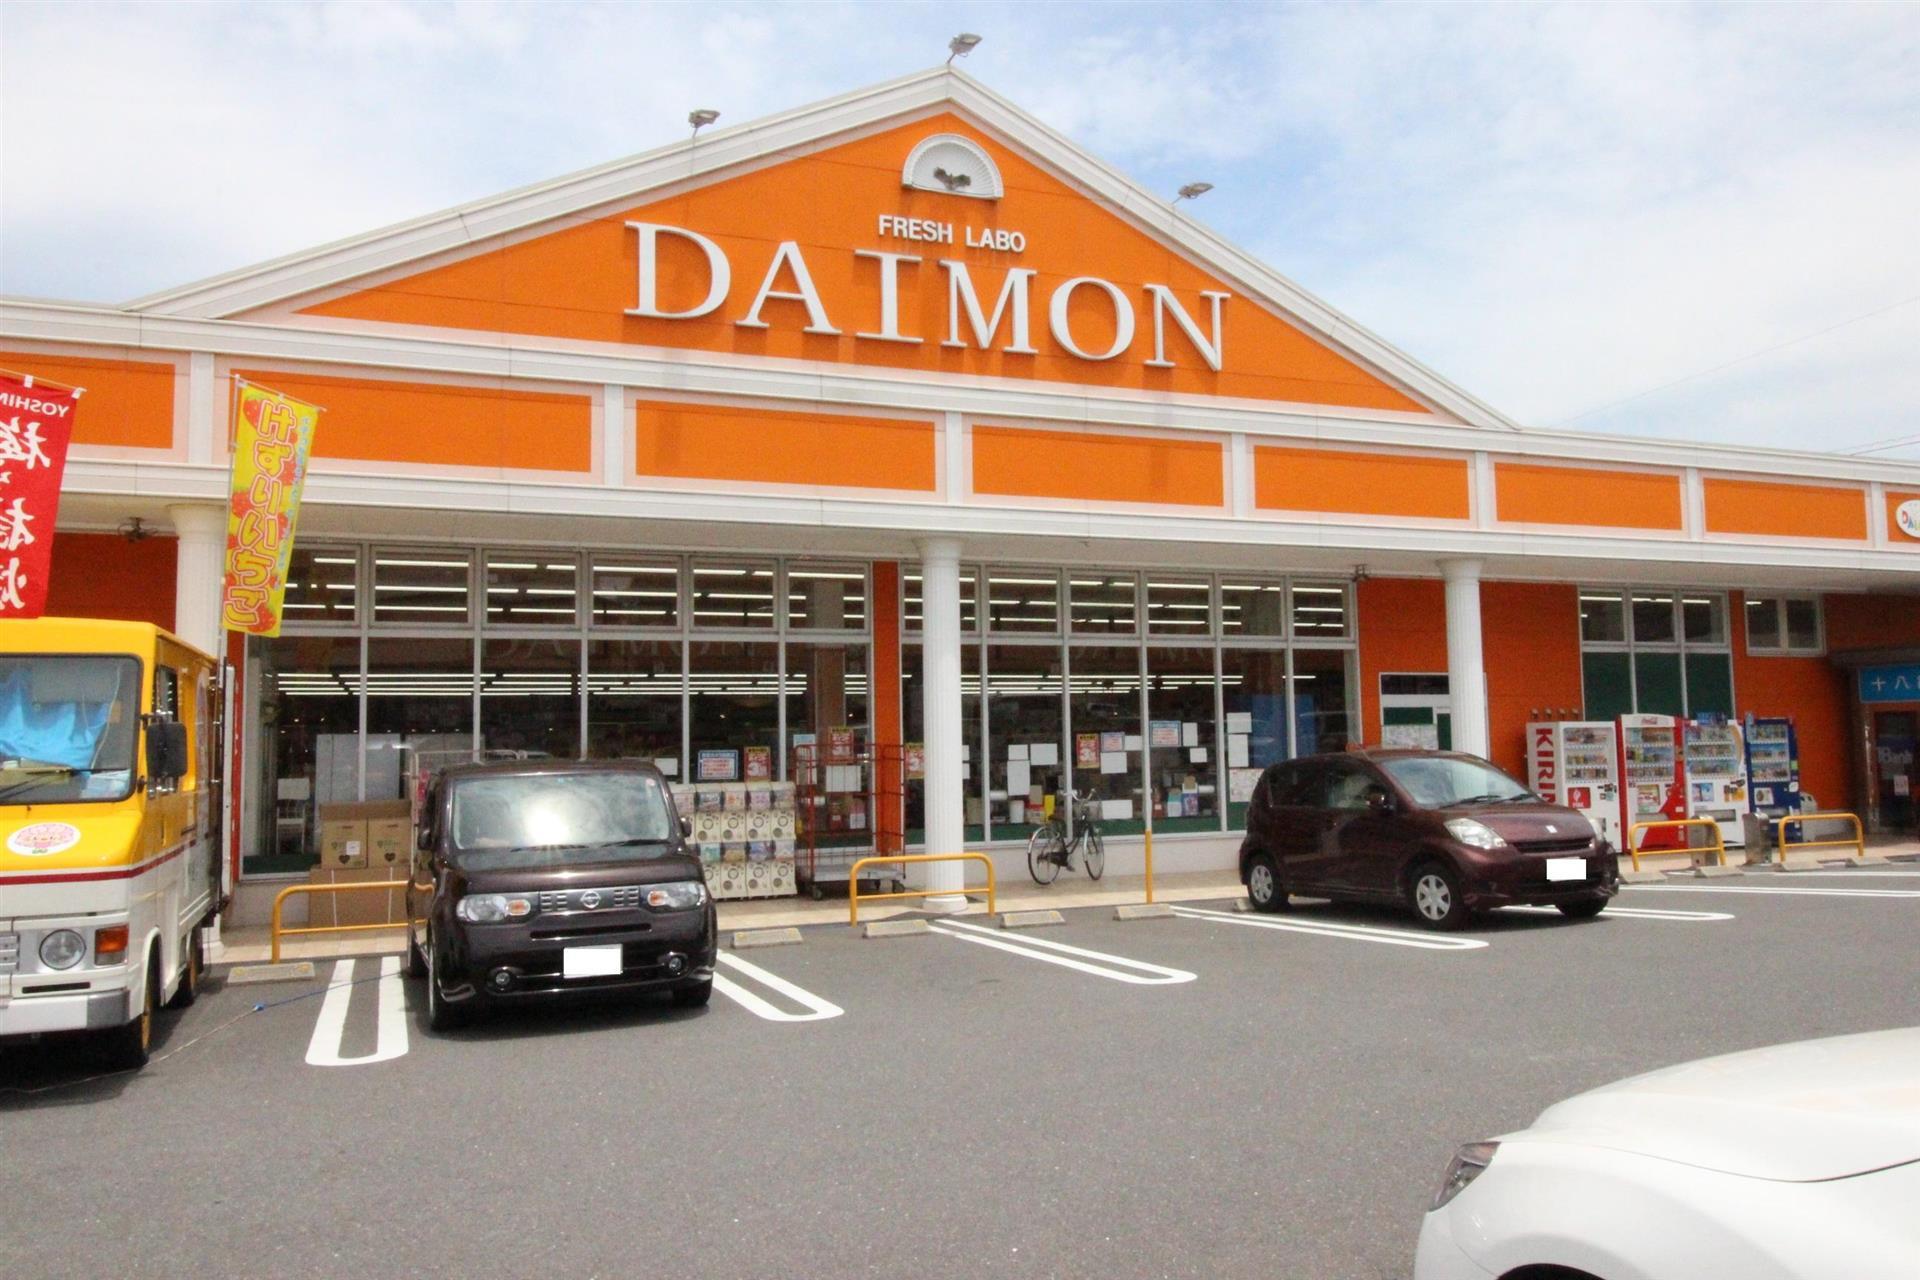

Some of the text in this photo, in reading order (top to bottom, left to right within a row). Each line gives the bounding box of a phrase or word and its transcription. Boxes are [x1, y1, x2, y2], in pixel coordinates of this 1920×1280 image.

[878, 214, 1026, 253] FRESH LABO
[623, 219, 1231, 372] DAIMON
[1871, 675, 1920, 691] 十八
